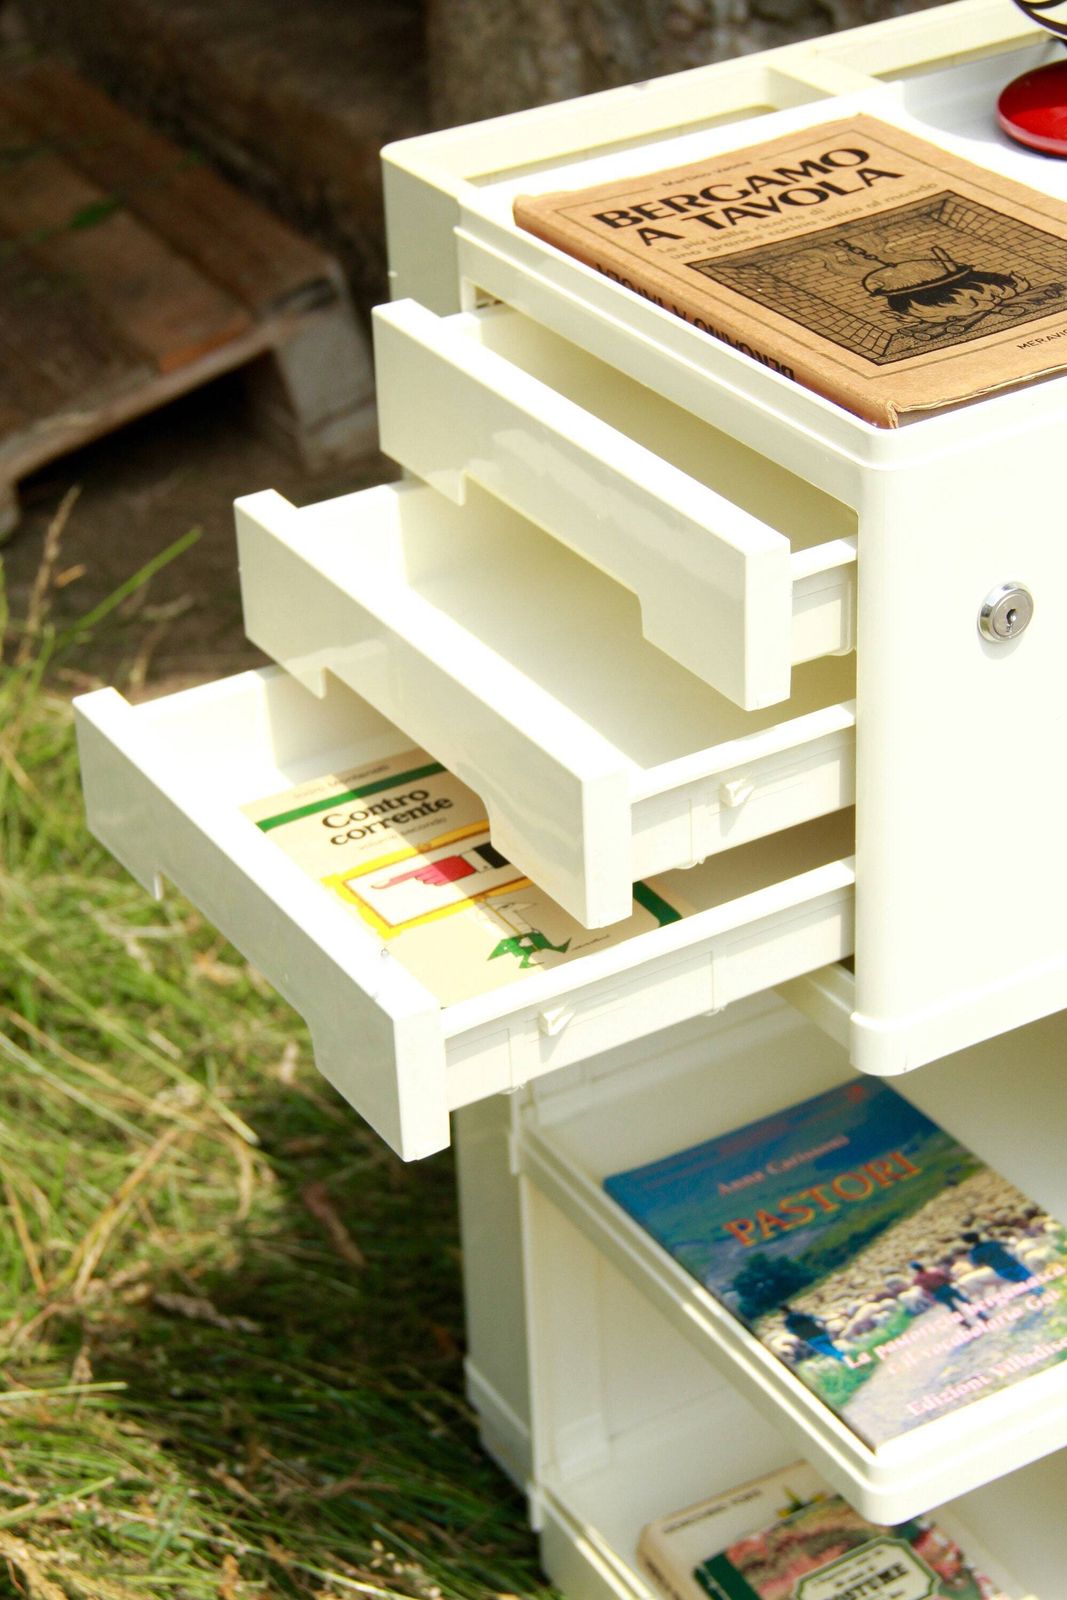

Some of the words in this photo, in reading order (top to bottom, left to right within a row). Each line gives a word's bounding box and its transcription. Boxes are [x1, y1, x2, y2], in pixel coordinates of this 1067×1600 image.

[592, 149, 870, 229] BERGAMO
[636, 227, 685, 246] A
[680, 168, 905, 230] TAVOLA
[706, 234, 764, 253] grande
[821, 206, 863, 222] unica
[866, 199, 882, 209] al
[883, 182, 938, 203] mondo
[321, 788, 431, 830] Contro
[329, 796, 455, 847] corrente
[723, 1150, 922, 1248] PASTORI
[843, 1350, 872, 1370] La
[906, 1372, 993, 1417] Edizioni
